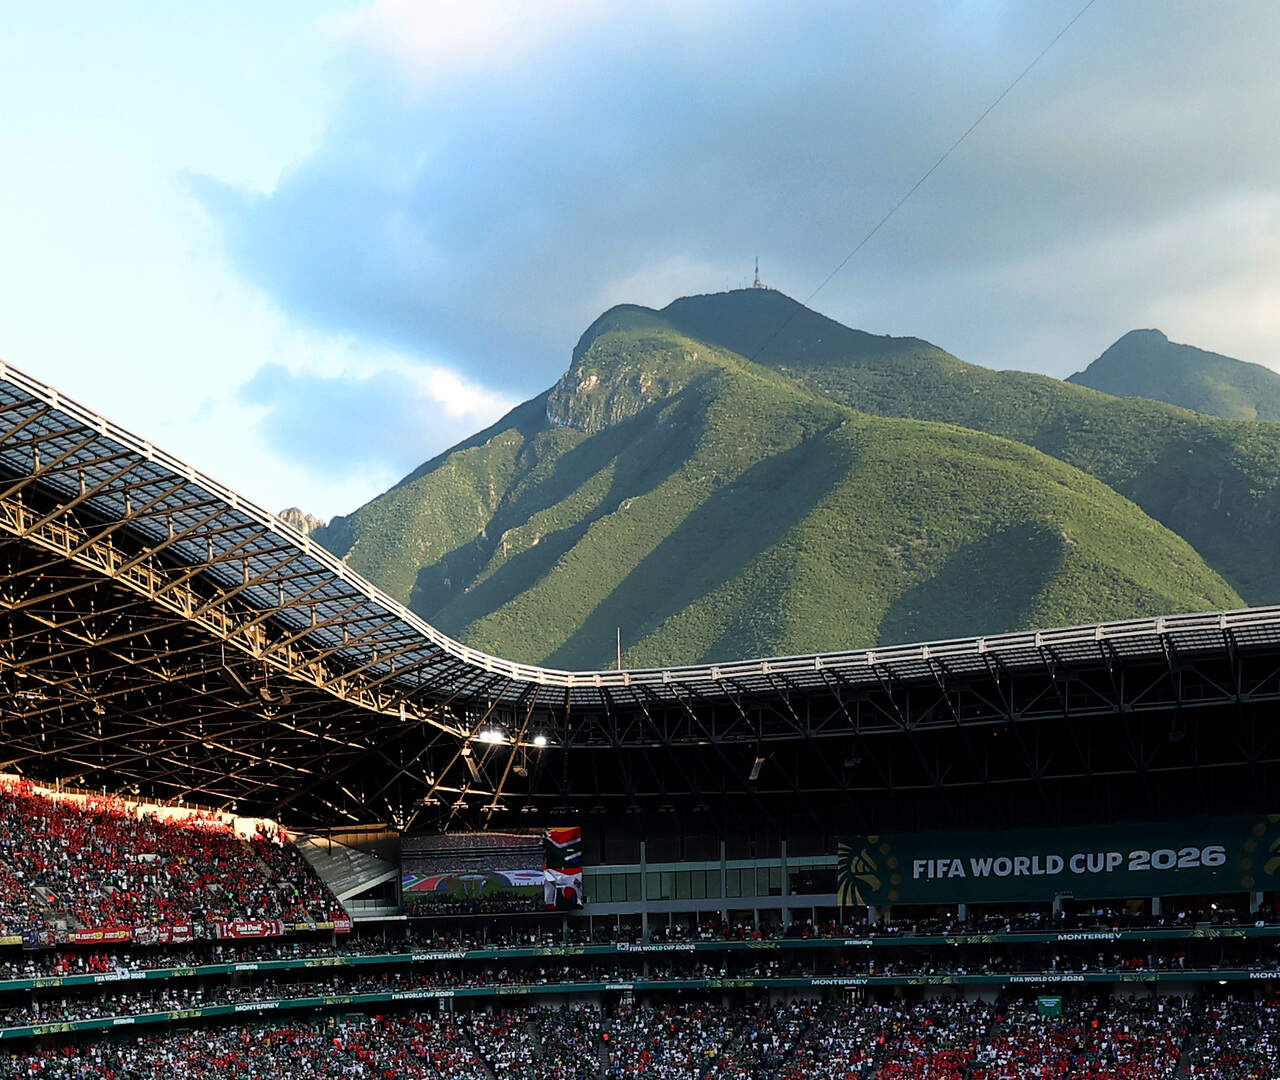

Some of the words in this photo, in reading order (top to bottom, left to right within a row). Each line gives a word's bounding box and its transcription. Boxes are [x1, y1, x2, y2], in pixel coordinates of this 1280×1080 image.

[913, 858, 966, 879] FIFA
[969, 855, 1065, 877] WORLD
[1069, 852, 1123, 874] CUP
[1128, 845, 1226, 871] 2026
[1057, 933, 1122, 941] MONTERREY
[411, 952, 466, 961] MONTERREY
[234, 1002, 280, 1012] MONTERREY
